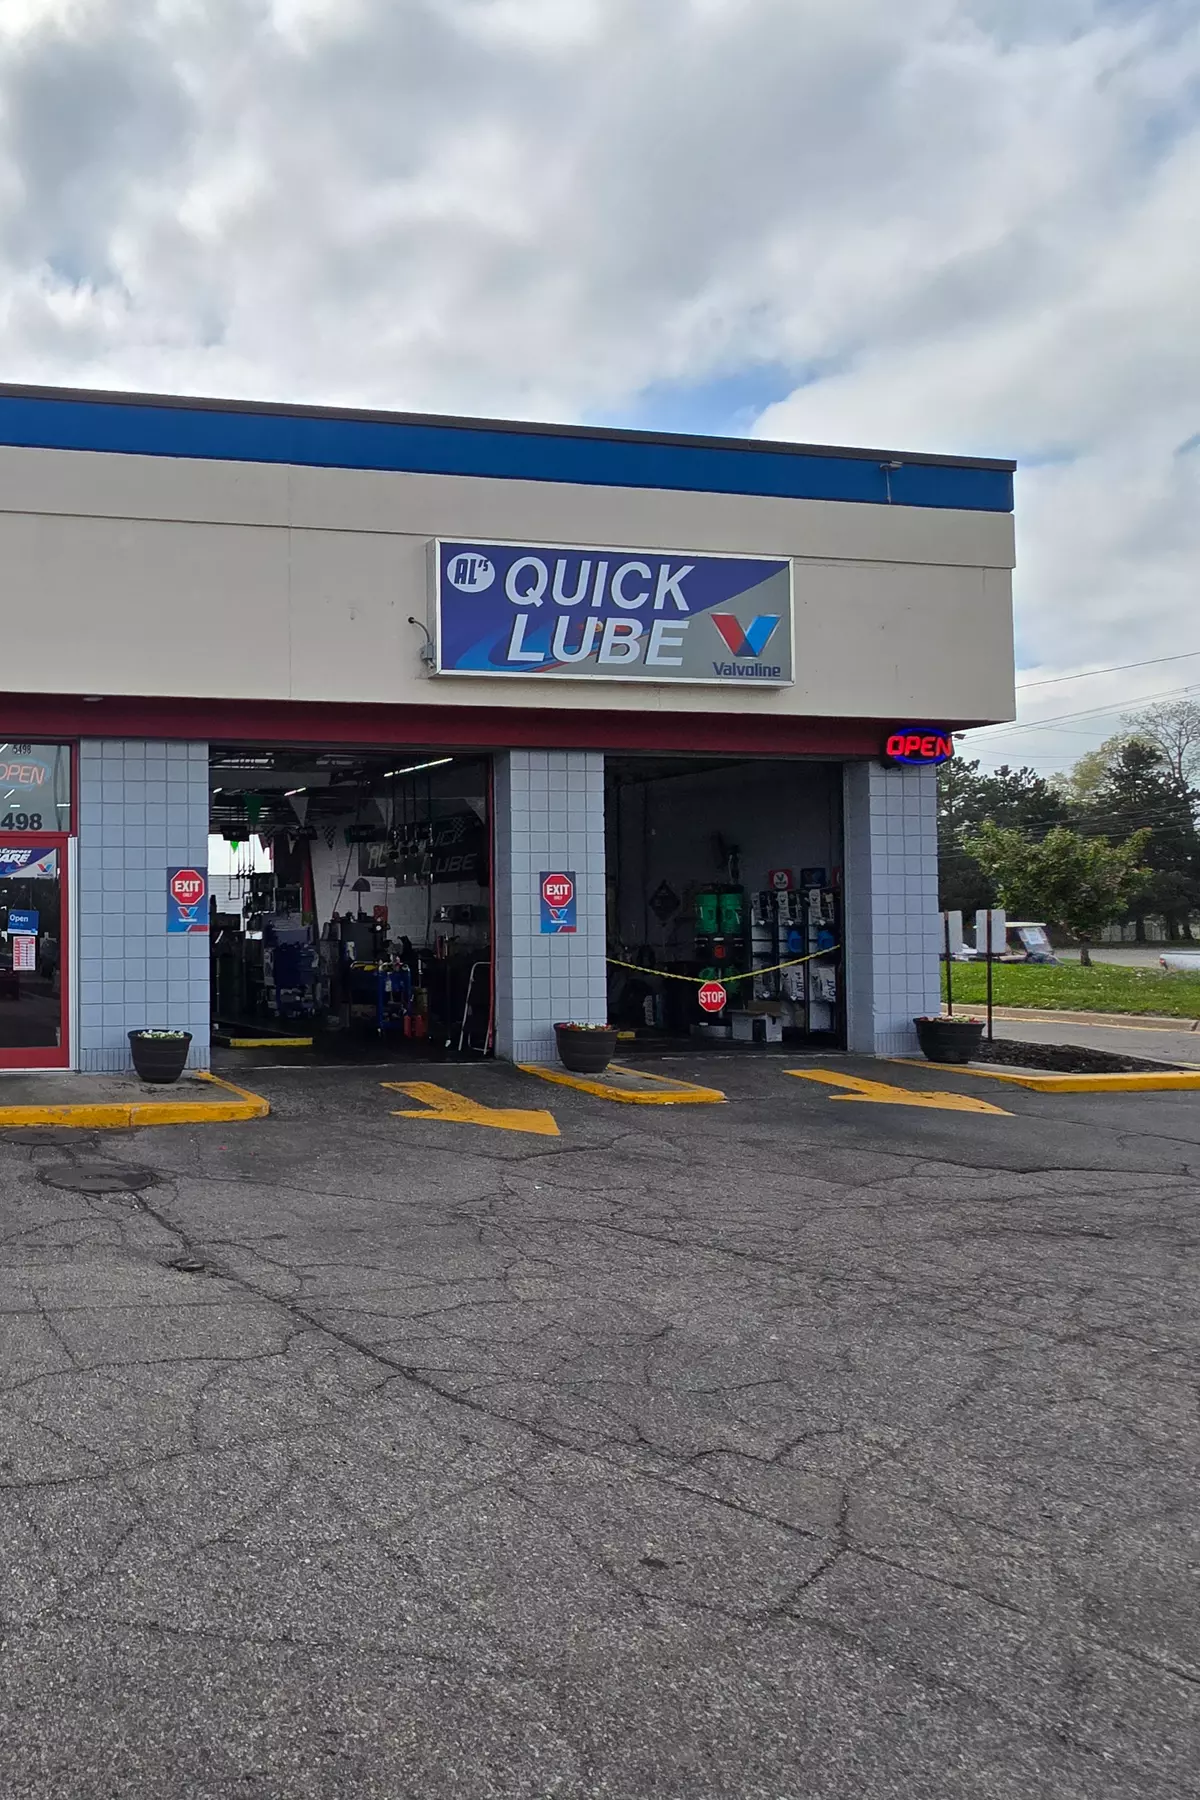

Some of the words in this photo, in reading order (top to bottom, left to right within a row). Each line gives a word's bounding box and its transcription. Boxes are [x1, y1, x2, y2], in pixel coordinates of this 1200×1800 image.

[505, 556, 696, 611] QUICK
[507, 613, 690, 666] LUBE
[712, 661, 781, 677] Valvoline
[12, 744, 32, 755] 5498
[886, 735, 952, 757] OPEN
[174, 880, 201, 893] EXIT
[546, 884, 570, 896] EXIT
[9, 914, 29, 923] Open
[700, 991, 725, 1003] STOP
